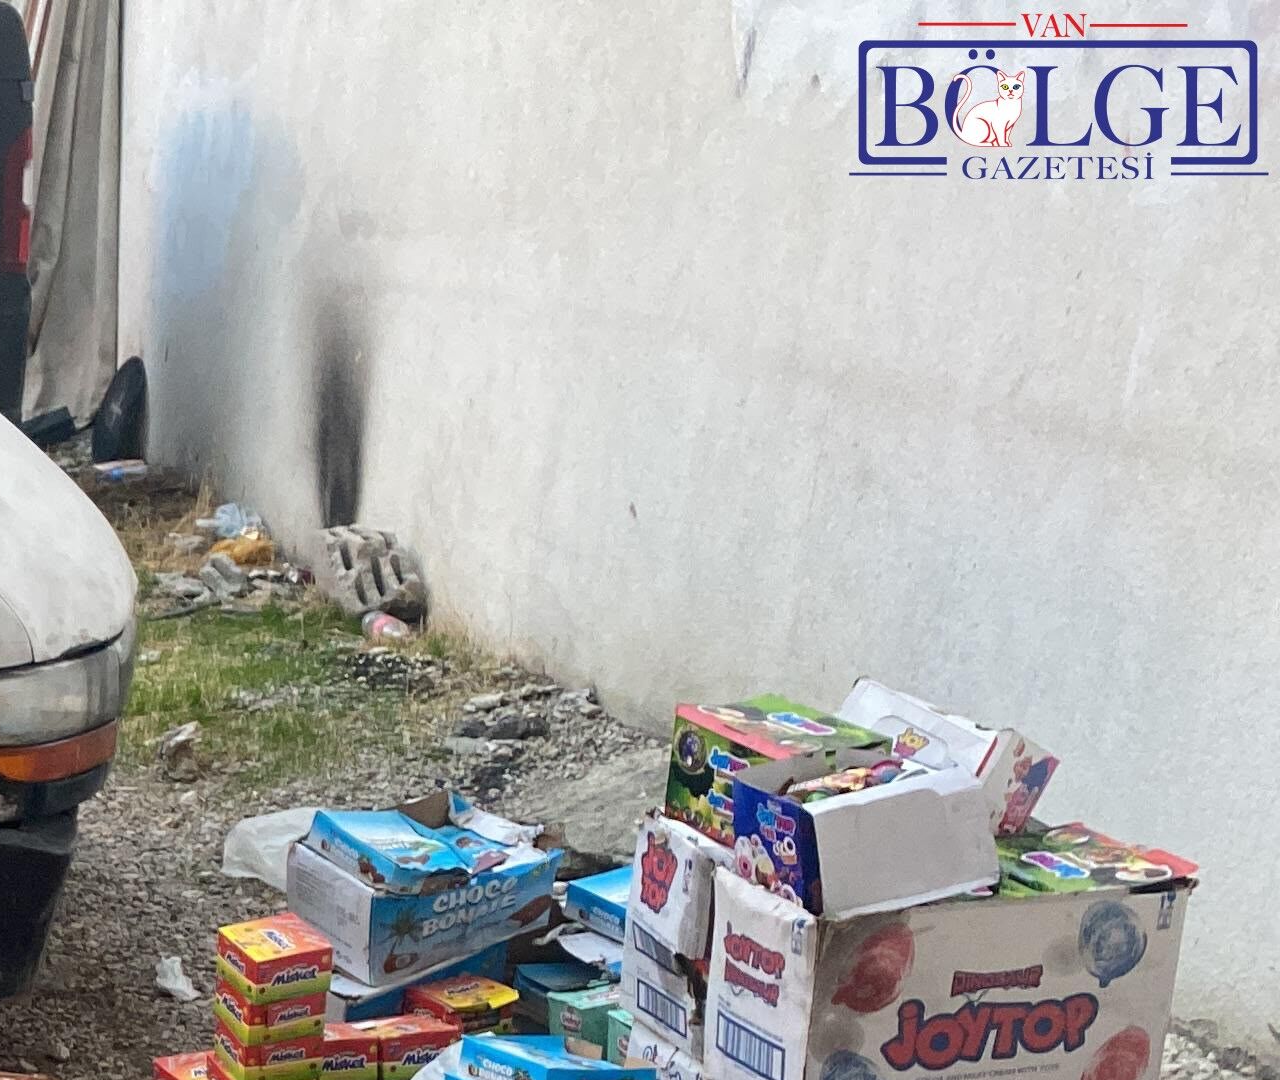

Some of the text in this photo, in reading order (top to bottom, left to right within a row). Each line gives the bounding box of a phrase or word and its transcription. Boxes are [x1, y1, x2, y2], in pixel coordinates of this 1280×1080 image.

[431, 878, 518, 913] CHOCO
[421, 894, 518, 937] BONATE
[880, 992, 1099, 1072] JOYTOP
[483, 1058, 513, 1075] CHOCO
